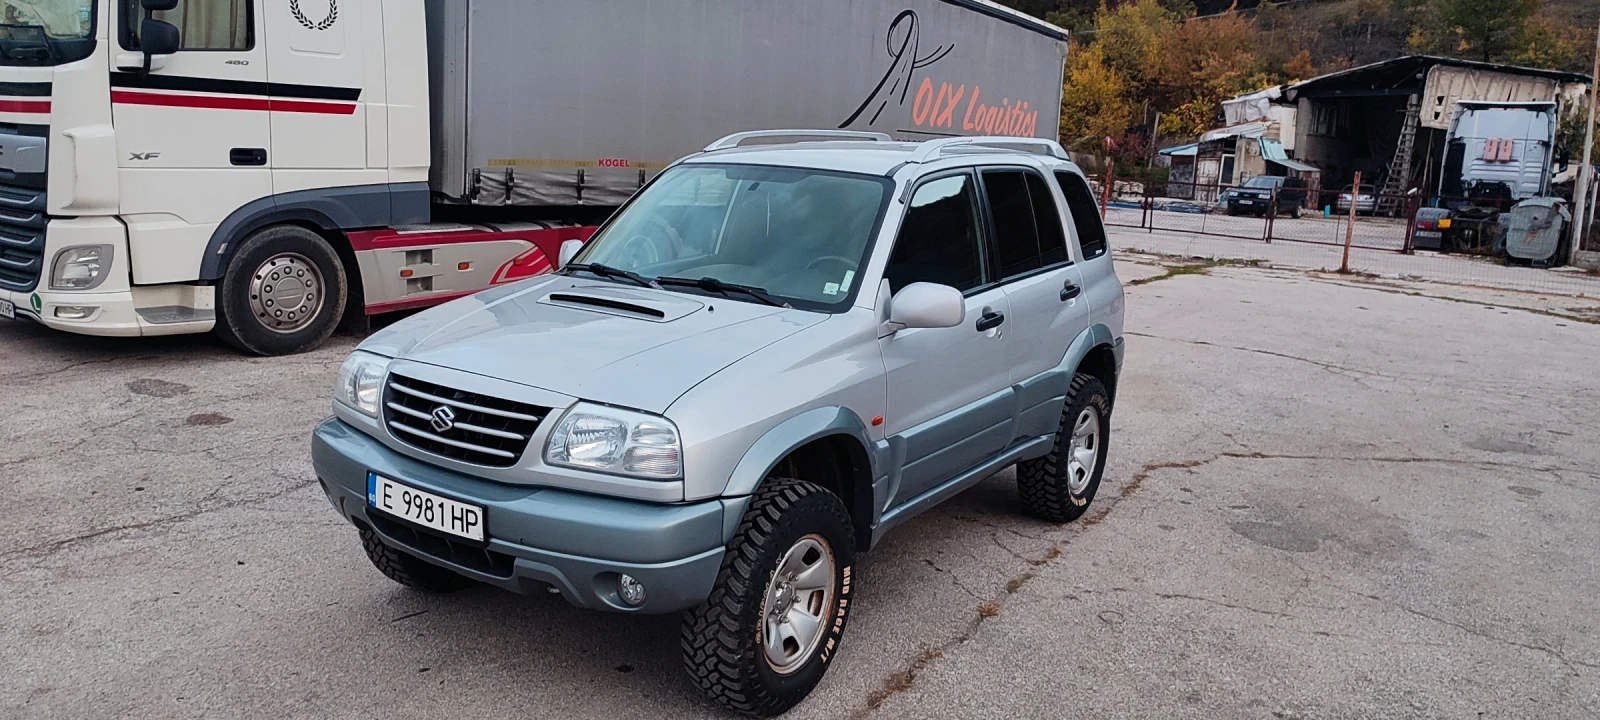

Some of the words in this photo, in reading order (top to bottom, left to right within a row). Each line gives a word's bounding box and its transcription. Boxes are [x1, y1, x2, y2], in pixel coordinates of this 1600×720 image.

[912, 77, 965, 128] OIX
[963, 85, 1037, 137] Logistics
[128, 152, 161, 161] XF
[842, 565, 851, 595] MUD
[820, 637, 835, 664] M/T
